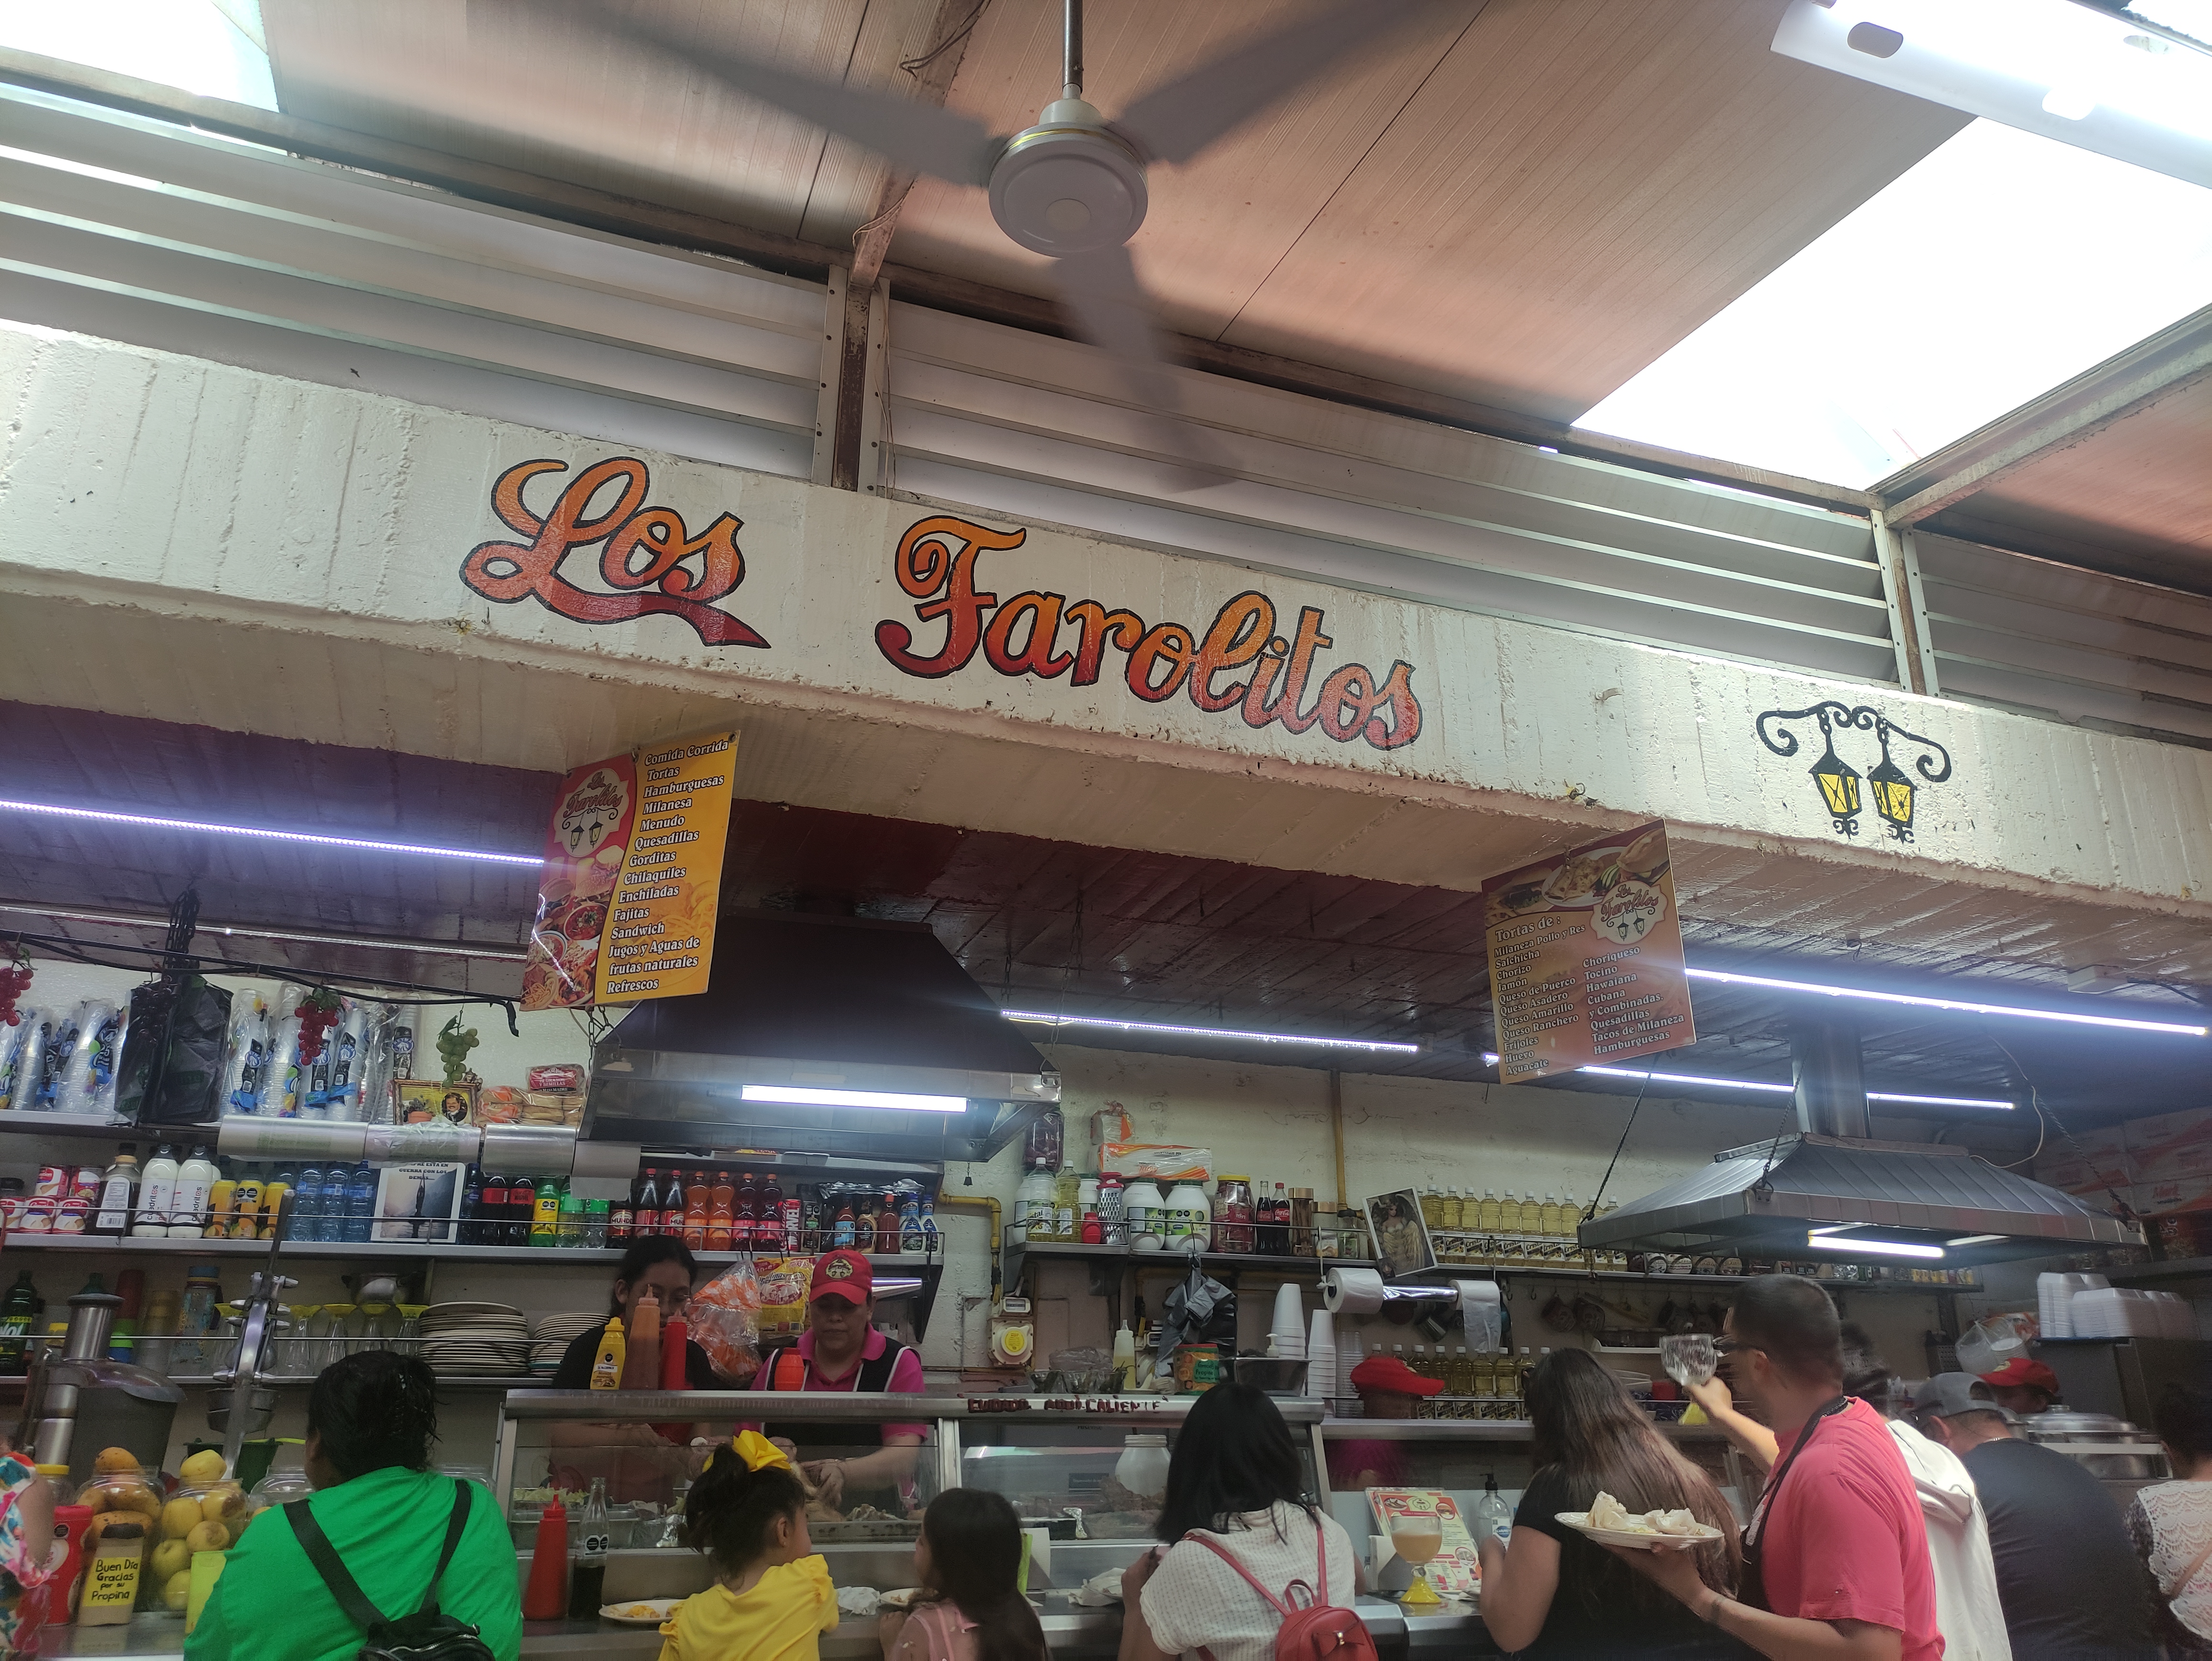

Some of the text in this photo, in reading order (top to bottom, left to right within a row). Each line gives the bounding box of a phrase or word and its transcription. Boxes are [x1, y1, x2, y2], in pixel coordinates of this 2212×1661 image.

[459, 456, 1423, 750] Los Farolitos
[645, 740, 729, 765] Comida Corrida
[587, 771, 607, 790] Los
[647, 767, 679, 782] Tortas
[643, 775, 724, 798] Hamburguesas
[563, 783, 623, 818] Farolitos
[642, 798, 692, 814] Milanesa
[640, 814, 685, 831] Menudo
[634, 830, 699, 852] Quesadillas
[629, 852, 676, 867] Gorditas
[623, 866, 686, 885] Chilaquiles
[619, 885, 679, 904] Enchiladas
[1615, 884, 1635, 898] Los
[613, 908, 650, 922] Fajitas
[1601, 889, 1659, 922] Farolitos
[610, 921, 665, 939] Sandwich
[1495, 922, 1535, 942] Tortas
[1537, 916, 1554, 930] de
[608, 936, 700, 958] Jugos y Aguas de
[1494, 925, 1585, 957] Milaneza Pollo y Res
[609, 955, 698, 976] frutas naturales
[1495, 950, 1540, 968] Salchicha
[1582, 946, 1640, 968] Choriqueso
[1496, 965, 1531, 980] Chorizo
[1584, 965, 1618, 981] Tocino
[607, 979, 659, 994] Refrescos
[1498, 977, 1527, 992] Jamón
[1499, 977, 1576, 1005] Queso de Puerco
[1586, 973, 1637, 993] Hawaiana
[1500, 992, 1568, 1017] Queso Asadero
[1587, 989, 1626, 1005] Cubana
[1589, 993, 1664, 1019] y Combinadas.
[1501, 1002, 1574, 1029] Queso Amarillo
[1590, 1009, 1650, 1031] Quesadillas
[1502, 1014, 1579, 1041] Queso Ranchero
[1592, 1014, 1684, 1042] Tacos de Milaneza
[1504, 1037, 1538, 1052] Frijoles
[1593, 1031, 1670, 1055] Hamburguesas
[1505, 1051, 1535, 1063] Huevo
[1506, 1060, 1549, 1075] Aguacate
[96, 1559, 122, 1572] Buen
[97, 1572, 134, 1581] Gracias
[91, 1591, 130, 1602] Propina
